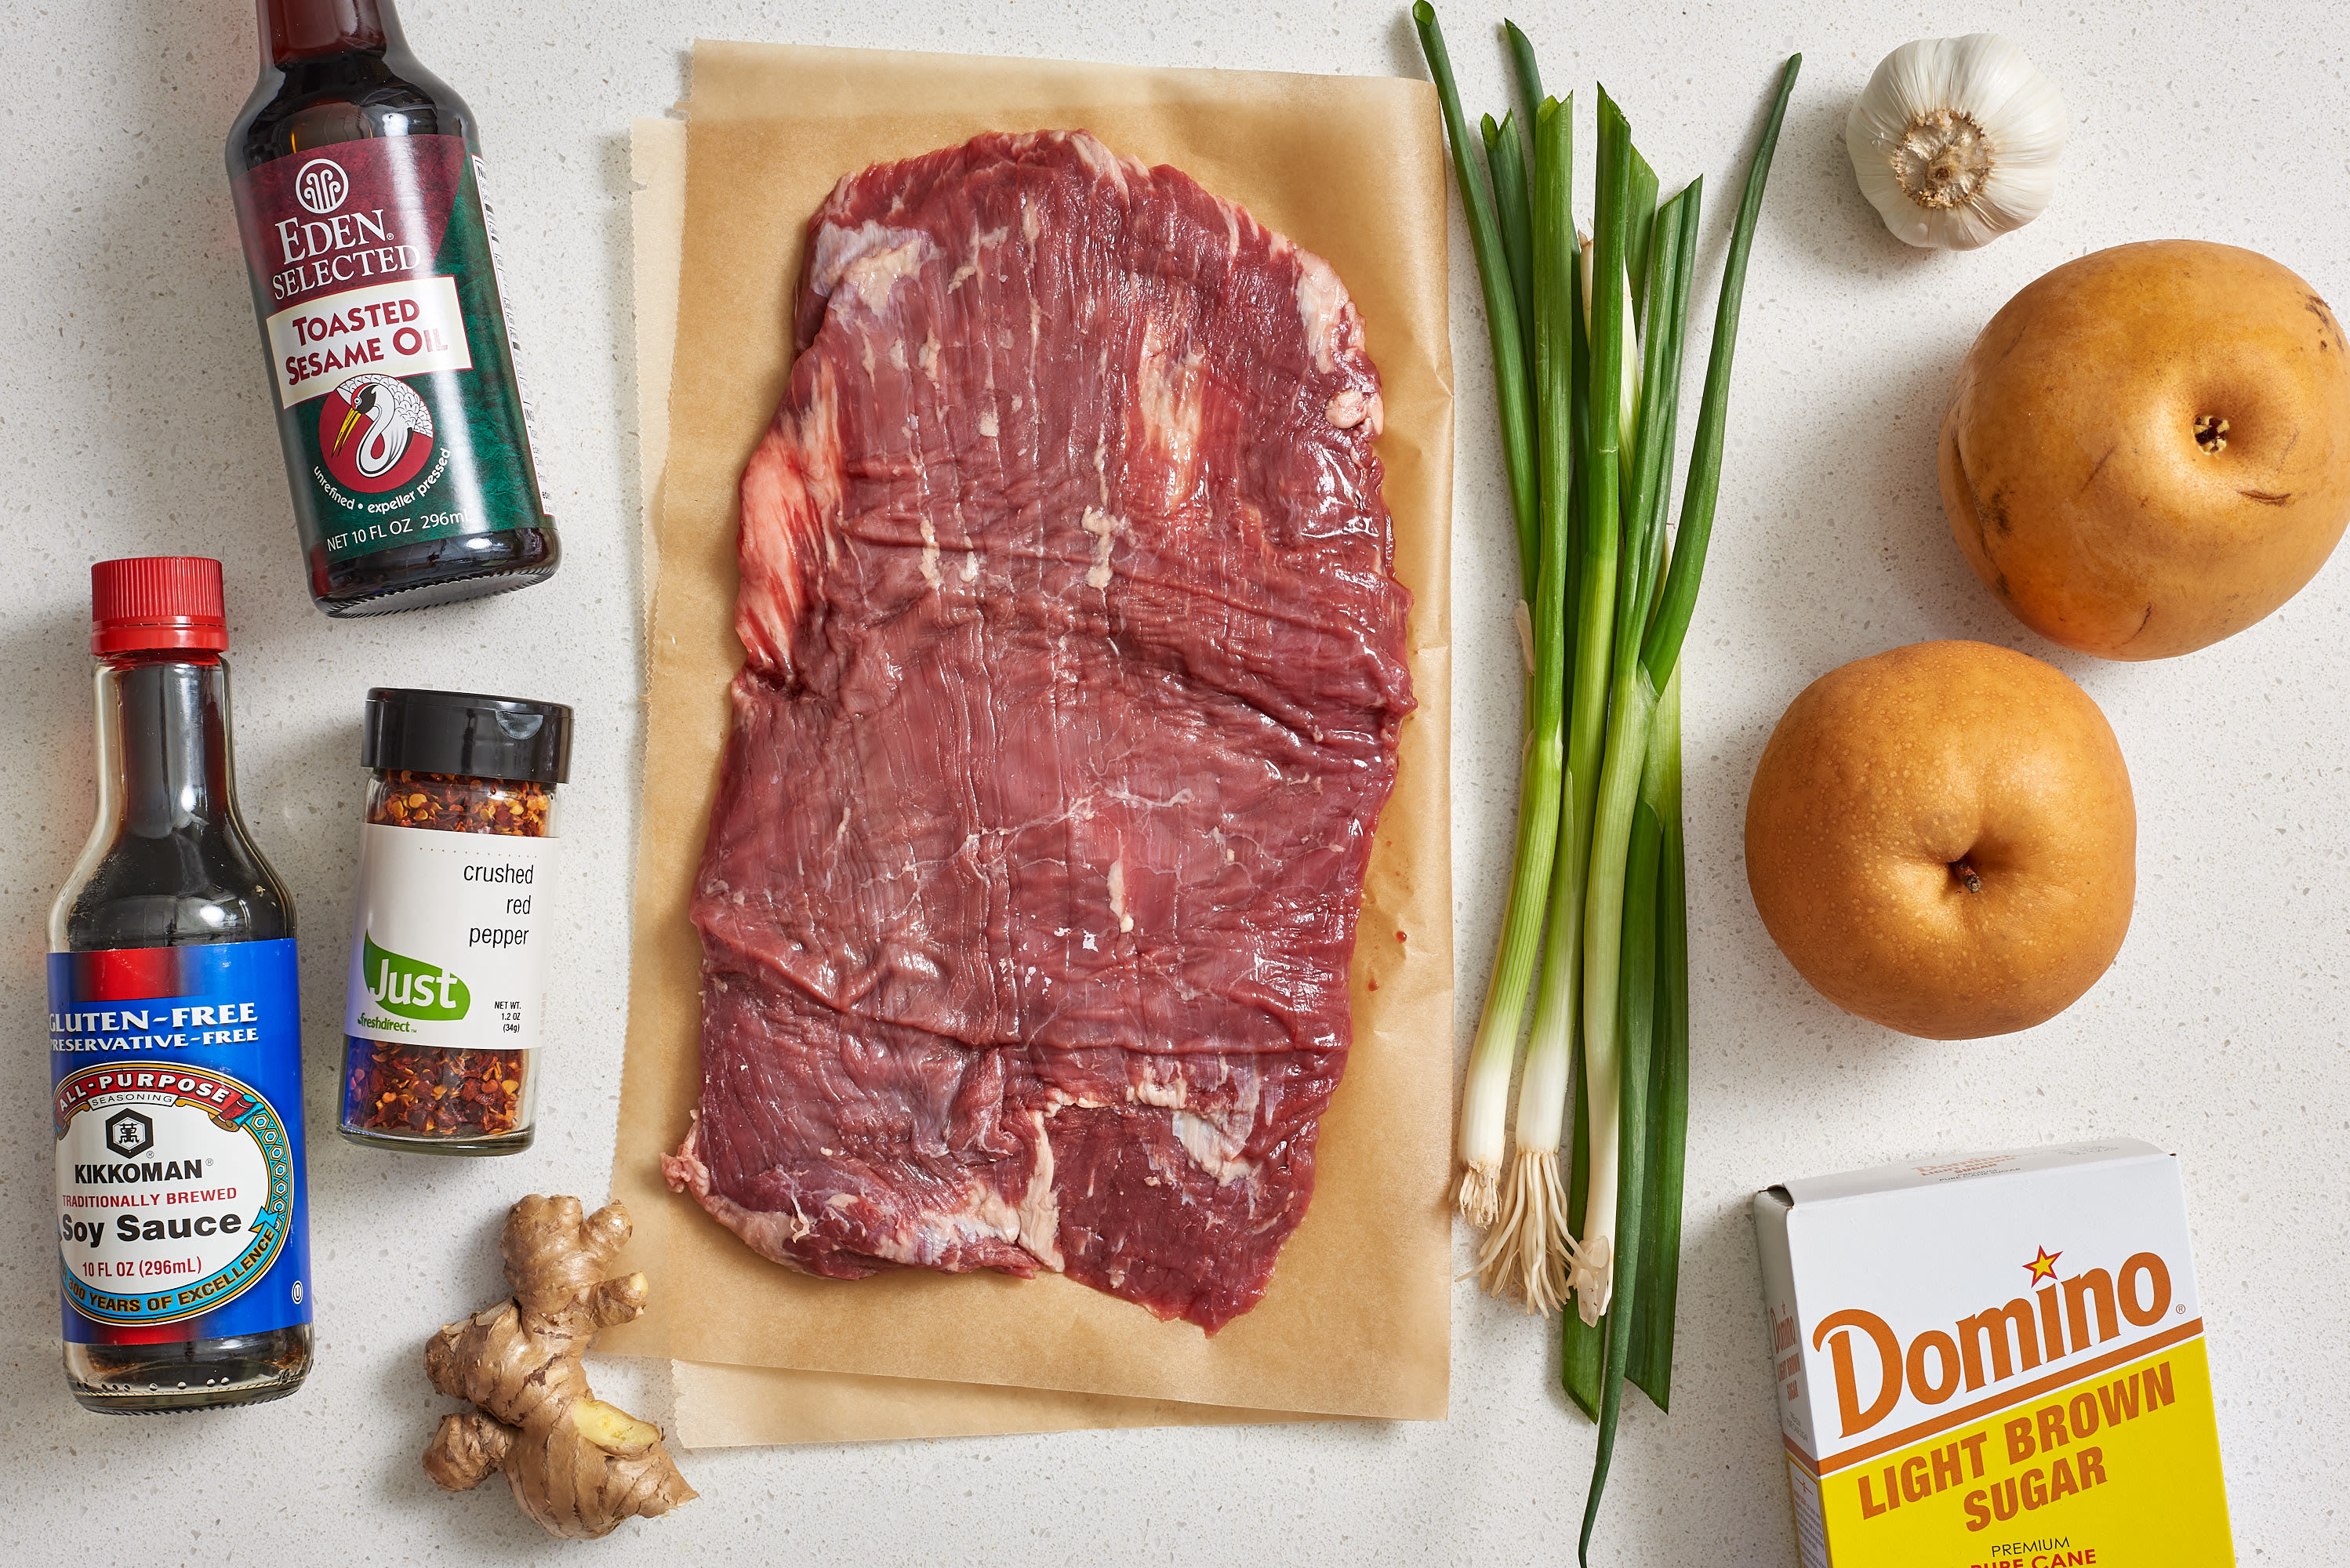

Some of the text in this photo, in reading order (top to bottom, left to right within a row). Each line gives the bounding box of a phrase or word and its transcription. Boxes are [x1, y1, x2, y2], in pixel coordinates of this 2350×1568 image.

[275, 209, 386, 265] EDEN
[272, 244, 421, 301] SELECTED
[292, 299, 420, 347] TOASTED
[285, 326, 449, 386] SESAME OIL
[314, 447, 452, 515] unrefined expeller pressed
[326, 509, 472, 552] NET 10 FL OZ 296mL
[463, 863, 534, 884] crushed
[506, 895, 532, 915] red
[469, 926, 529, 949] pepper
[369, 957, 459, 1009] Just
[49, 1002, 258, 1033] GLUTEN-FREE
[494, 1000, 521, 1010] NET WT.
[501, 1012, 521, 1021] 1.2 OZ
[358, 1012, 410, 1033] freshdirect
[503, 1023, 521, 1033] (34g)
[49, 1028, 260, 1052] PRESERVATIVE-FREE
[59, 1073, 231, 1113] ALL-PURPOSE
[92, 1093, 173, 1107] SEASONING
[74, 1159, 203, 1185] KIKKOMAN
[62, 1187, 237, 1207] TRADITIONALLY BREWED
[62, 1214, 242, 1248] Soy Sauce
[82, 1261, 95, 1277] 10
[97, 1261, 113, 1277] FL
[117, 1261, 135, 1277] OZ
[139, 1255, 202, 1279] (296mL)
[89, 1291, 141, 1313] YEARS
[147, 1294, 173, 1312] OF
[177, 1227, 276, 1306] EXCELLENCE
[1812, 1251, 2172, 1439] Domino
[1858, 1361, 2177, 1521] LIGHT BROWN
[1963, 1446, 2108, 1533] SUGAR
[1992, 1536, 2070, 1558] PREMIUM
[2031, 1548, 2097, 1568] CANE
